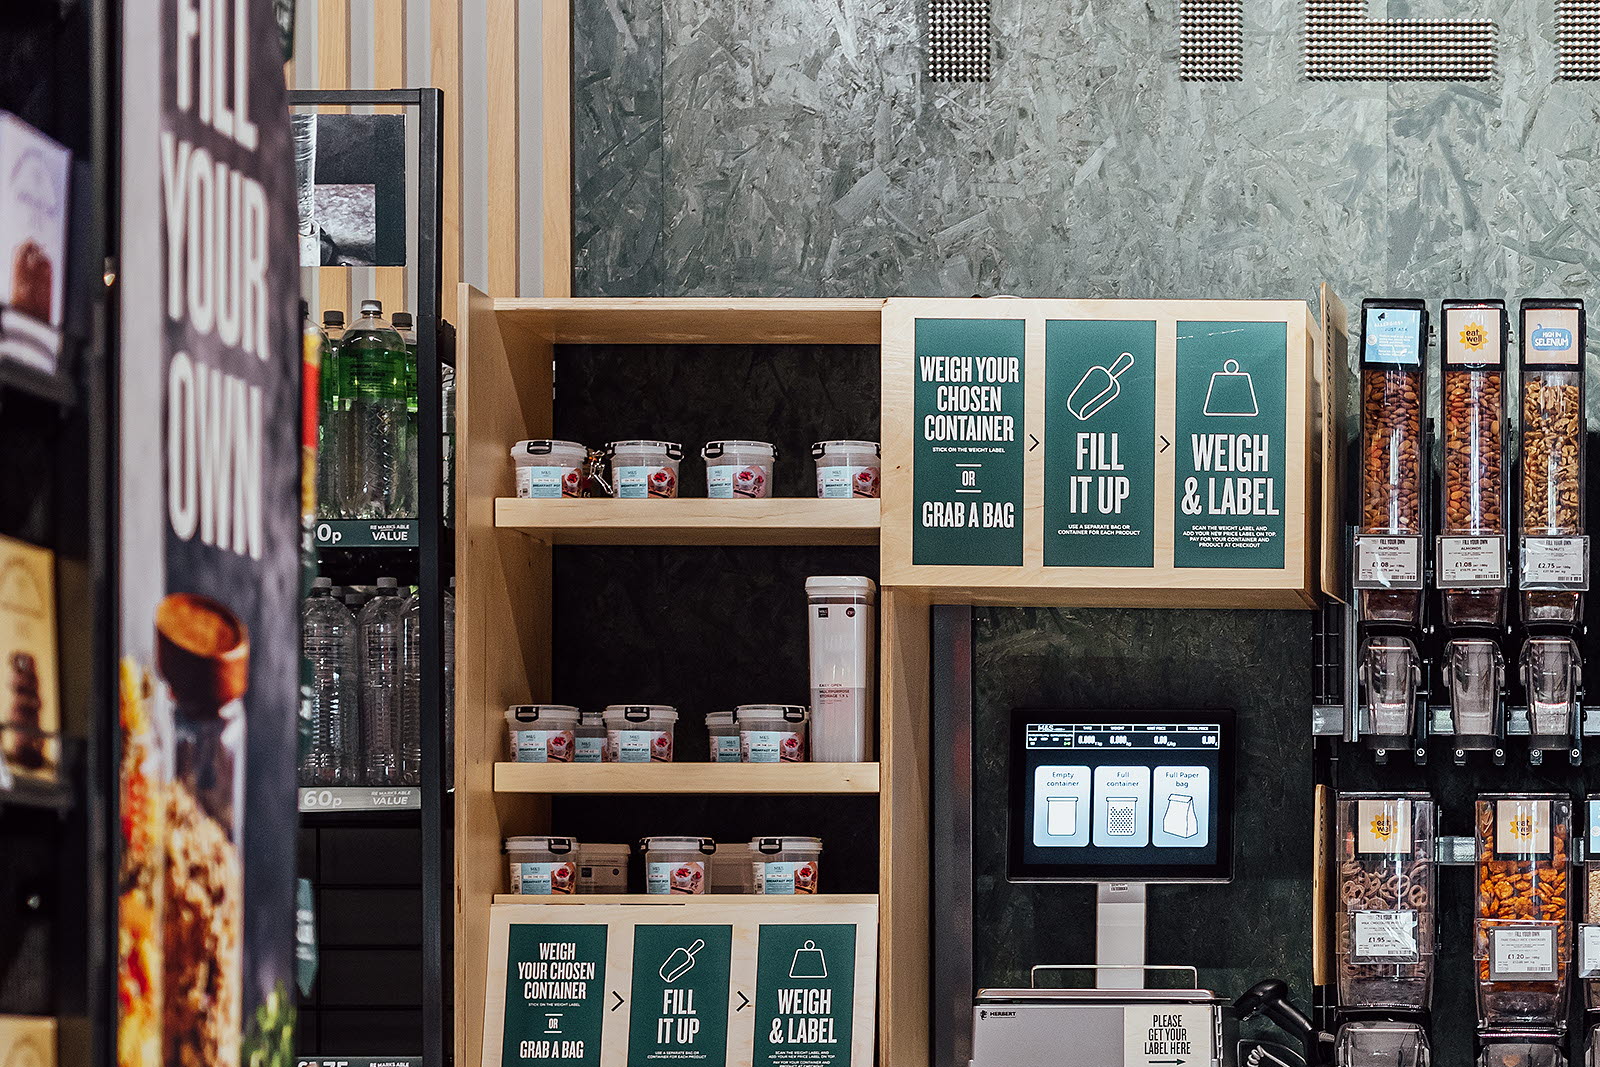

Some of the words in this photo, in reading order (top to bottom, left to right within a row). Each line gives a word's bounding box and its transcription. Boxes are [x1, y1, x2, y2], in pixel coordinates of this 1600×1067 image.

[176, 0, 258, 151] FILL
[160, 131, 269, 362] YOUR
[1466, 335, 1482, 343] well
[1534, 336, 1568, 348] SELENIUM
[920, 356, 972, 382] WEIGH
[975, 356, 1019, 383] YOUR
[937, 385, 1002, 412] CHOSEN
[924, 414, 1014, 442] CONTAINER
[168, 351, 262, 562] OWN
[1076, 432, 1124, 470] FILL
[1191, 434, 1269, 472] WEIGH
[962, 470, 976, 486] OR
[1070, 476, 1092, 513] IT
[1098, 476, 1130, 514] UP
[1181, 476, 1202, 515] &
[1208, 477, 1280, 515] LABEL
[922, 501, 965, 527] GRAB
[968, 502, 979, 528] A
[983, 502, 1014, 528] BAG
[372, 531, 408, 540] VALUE
[1052, 772, 1074, 780] Empty
[304, 790, 342, 808] 60p
[372, 797, 408, 805] VALUE
[539, 942, 576, 960] WEIGH
[518, 962, 548, 980] YOUR
[550, 962, 595, 980] CHOSEN
[524, 981, 586, 1000] CONTAINER
[778, 988, 832, 1015] WEIGH
[663, 989, 696, 1015] FILL
[548, 1018, 558, 1029] OR
[657, 1018, 674, 1044] IT
[677, 1018, 700, 1044] UP
[769, 1018, 784, 1044] &
[788, 1018, 837, 1043] LABEL
[1153, 1014, 1182, 1028] PLEASE
[1148, 1028, 1164, 1041] GET
[1166, 1028, 1187, 1041] YOUR
[520, 1040, 550, 1058] GRAB
[551, 1041, 559, 1058] A
[561, 1040, 584, 1058] BAG
[1144, 1042, 1168, 1054] LABEL
[1170, 1042, 1191, 1054] HERE
